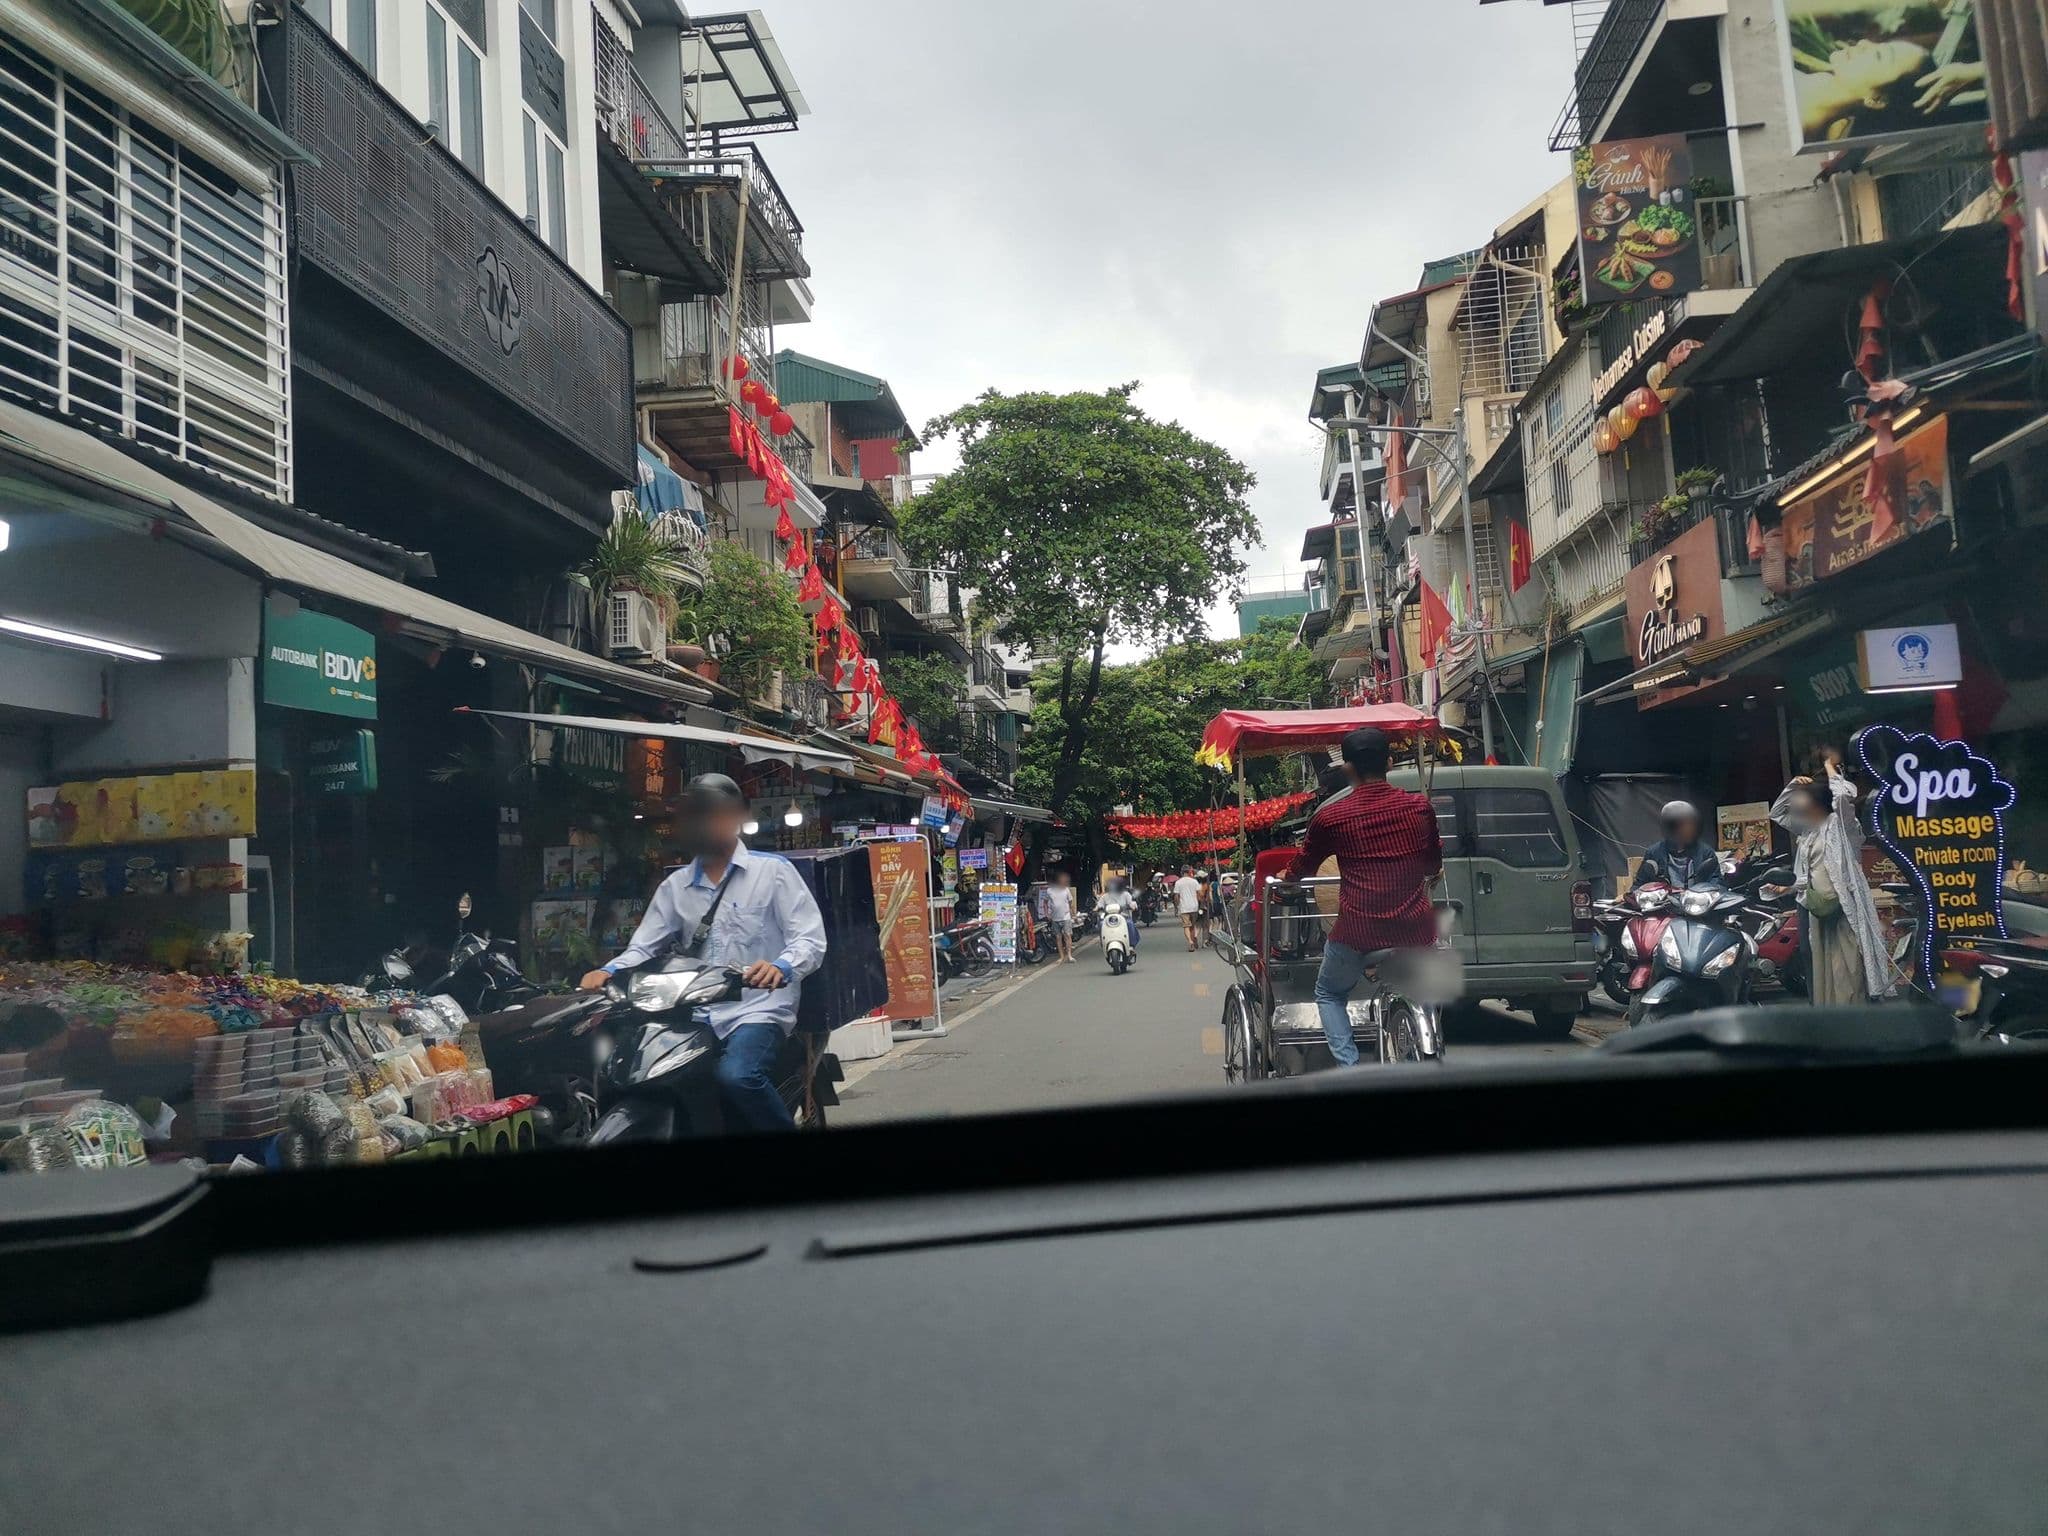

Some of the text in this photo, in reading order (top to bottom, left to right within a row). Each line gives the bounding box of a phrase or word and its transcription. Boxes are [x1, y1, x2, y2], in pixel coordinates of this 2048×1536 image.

[1633, 310, 1665, 360] Cuisine
[271, 646, 363, 683] AUTOBANK BIDV
[1891, 753, 1976, 817] Spa
[1896, 815, 1994, 839] Massage
[1915, 846, 1996, 866] Private room
[1932, 870, 1976, 889] Body
[1939, 892, 1978, 907] Foot
[1937, 912, 1995, 932] Eyelash
